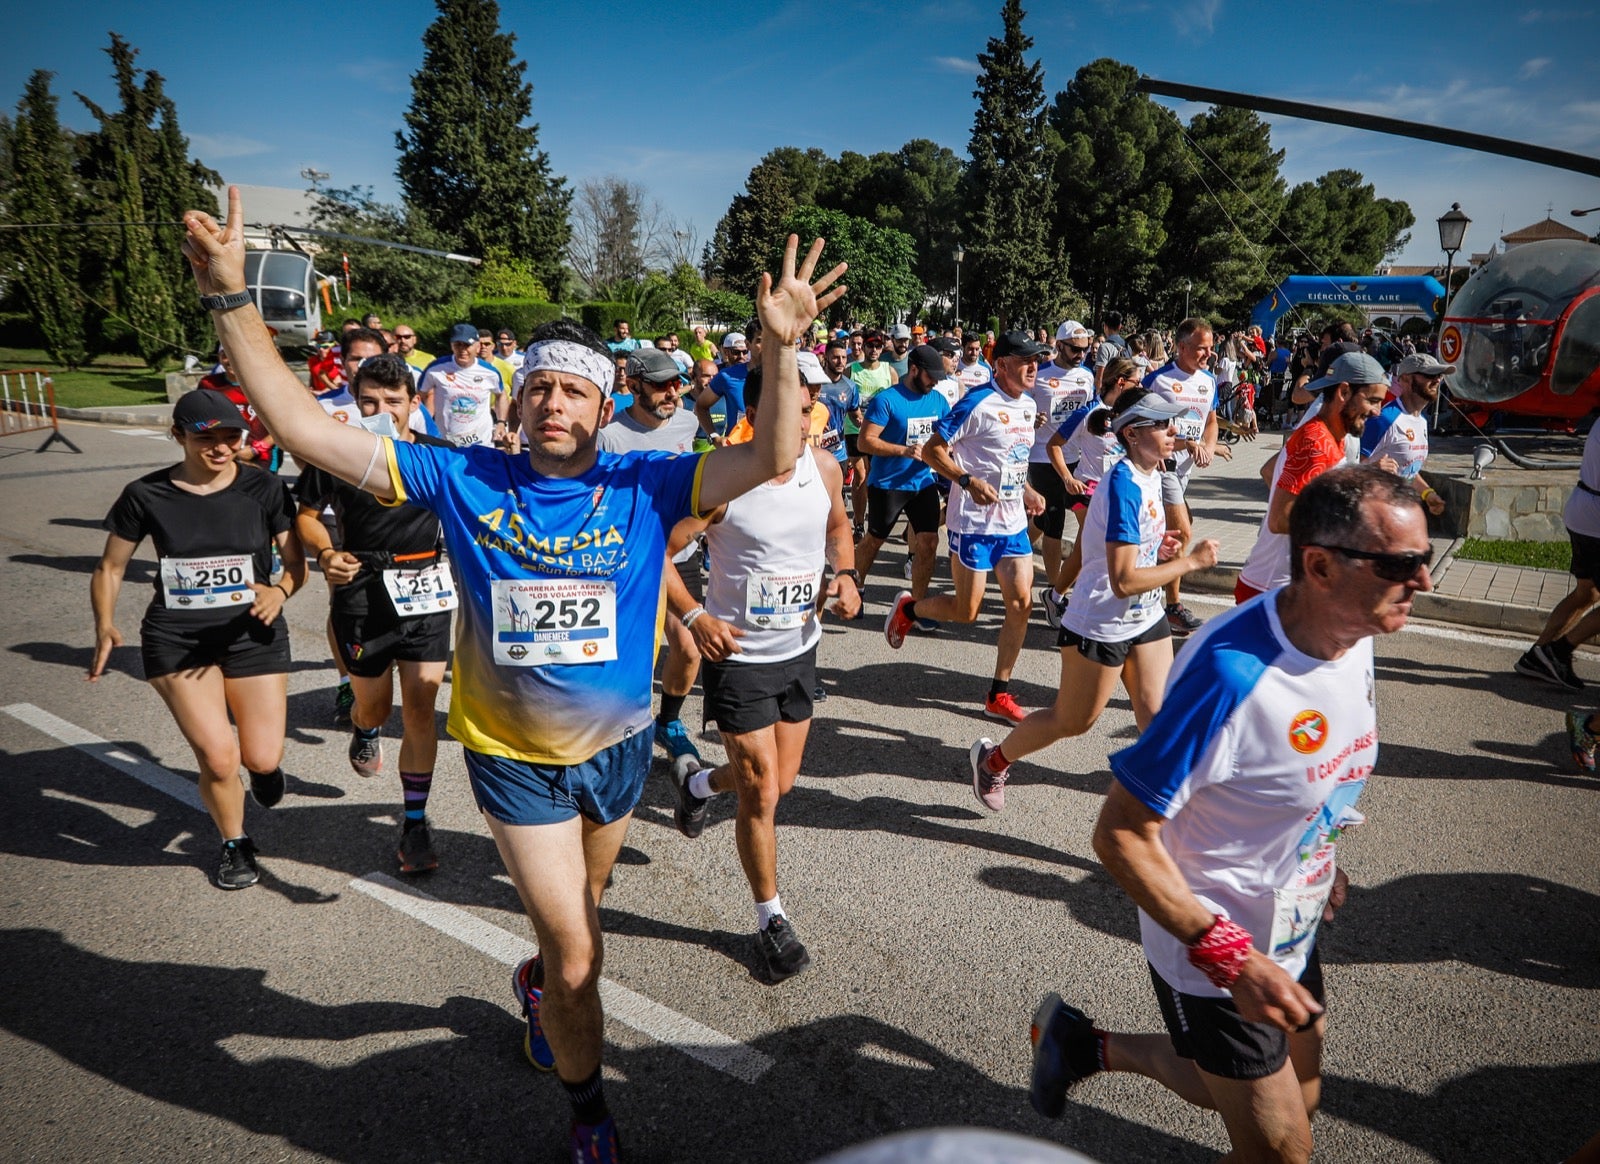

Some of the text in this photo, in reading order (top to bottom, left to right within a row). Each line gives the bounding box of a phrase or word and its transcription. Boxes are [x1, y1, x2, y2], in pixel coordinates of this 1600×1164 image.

[1308, 292, 1349, 301] EJÉRCITO
[1062, 401, 1081, 411] 287
[920, 424, 933, 434] 26
[1187, 425, 1200, 436] 209
[460, 433, 479, 446] 305
[1016, 471, 1027, 485] 32
[478, 508, 625, 555] 45 MEDIA
[195, 566, 243, 588] 250
[537, 563, 562, 575] Run
[565, 566, 584, 577] for
[408, 575, 443, 595] 251
[777, 583, 813, 605] 129
[535, 598, 601, 630] 252
[534, 631, 570, 641] DANIEMECE
